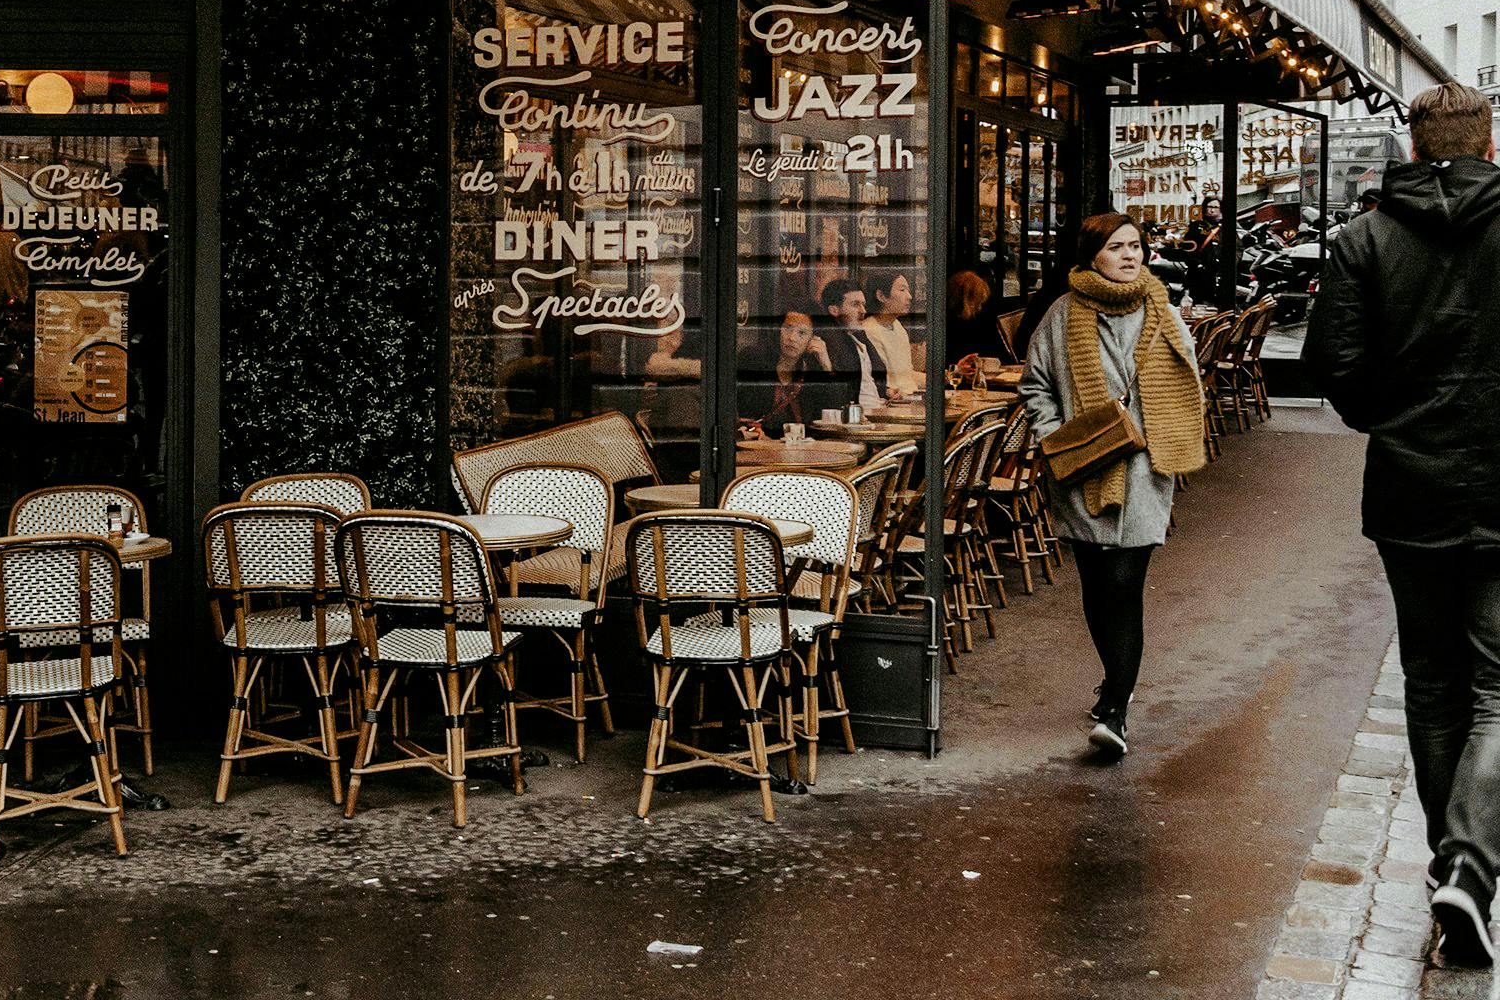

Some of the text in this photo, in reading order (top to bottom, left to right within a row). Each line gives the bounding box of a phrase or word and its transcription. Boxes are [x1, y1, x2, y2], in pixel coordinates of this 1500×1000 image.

[473, 21, 685, 69] SERVICE
[749, 0, 922, 63] Concert
[479, 70, 676, 146] Continu
[754, 72, 918, 120] JAZZ
[460, 160, 499, 194] de
[636, 166, 695, 192] matin
[652, 150, 675, 165] du
[742, 148, 767, 178] Le
[767, 149, 819, 182] jeudi
[845, 133, 914, 170] 21h
[30, 164, 124, 200] Petit
[14, 235, 145, 287] Complet
[495, 220, 660, 261] DINER
[453, 266, 686, 336] après Spectacles
